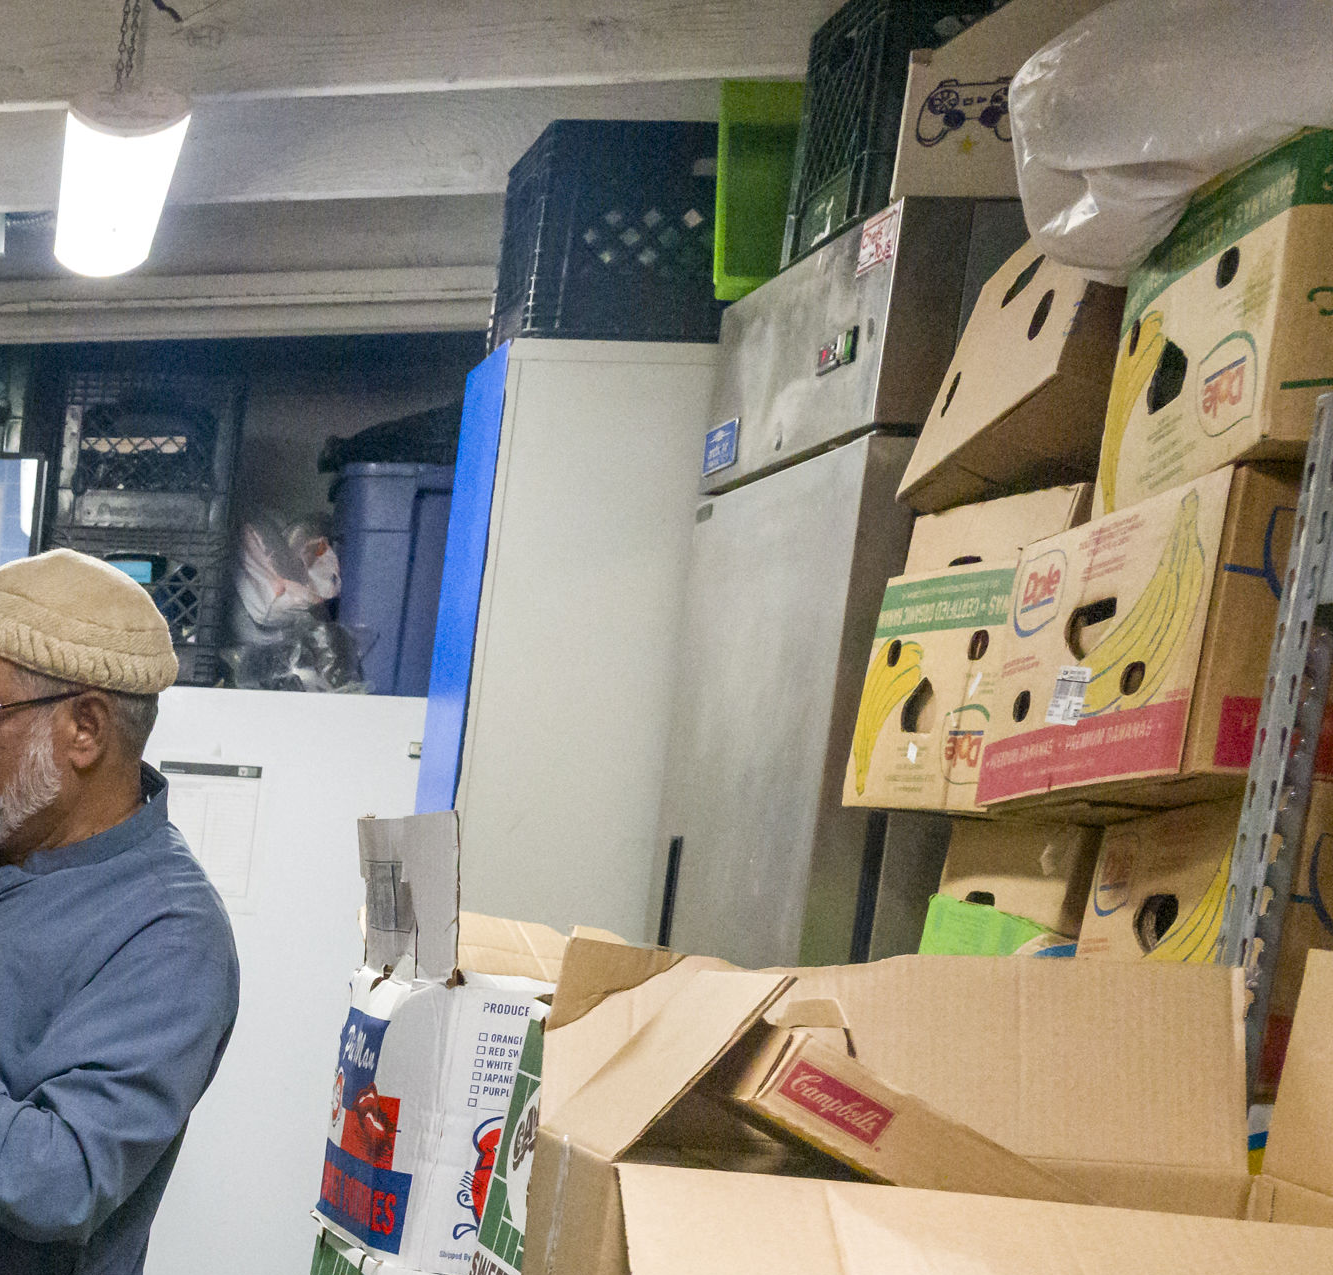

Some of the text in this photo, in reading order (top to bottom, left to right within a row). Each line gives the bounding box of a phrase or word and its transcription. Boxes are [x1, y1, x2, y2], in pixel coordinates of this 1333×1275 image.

[1022, 564, 1061, 605] Dole
[945, 733, 983, 769] Dole
[1065, 727, 1105, 751] PREMIUM
[1107, 719, 1155, 743] BANANAS
[486, 1060, 513, 1071] WHITE
[488, 1046, 505, 1056] RED
